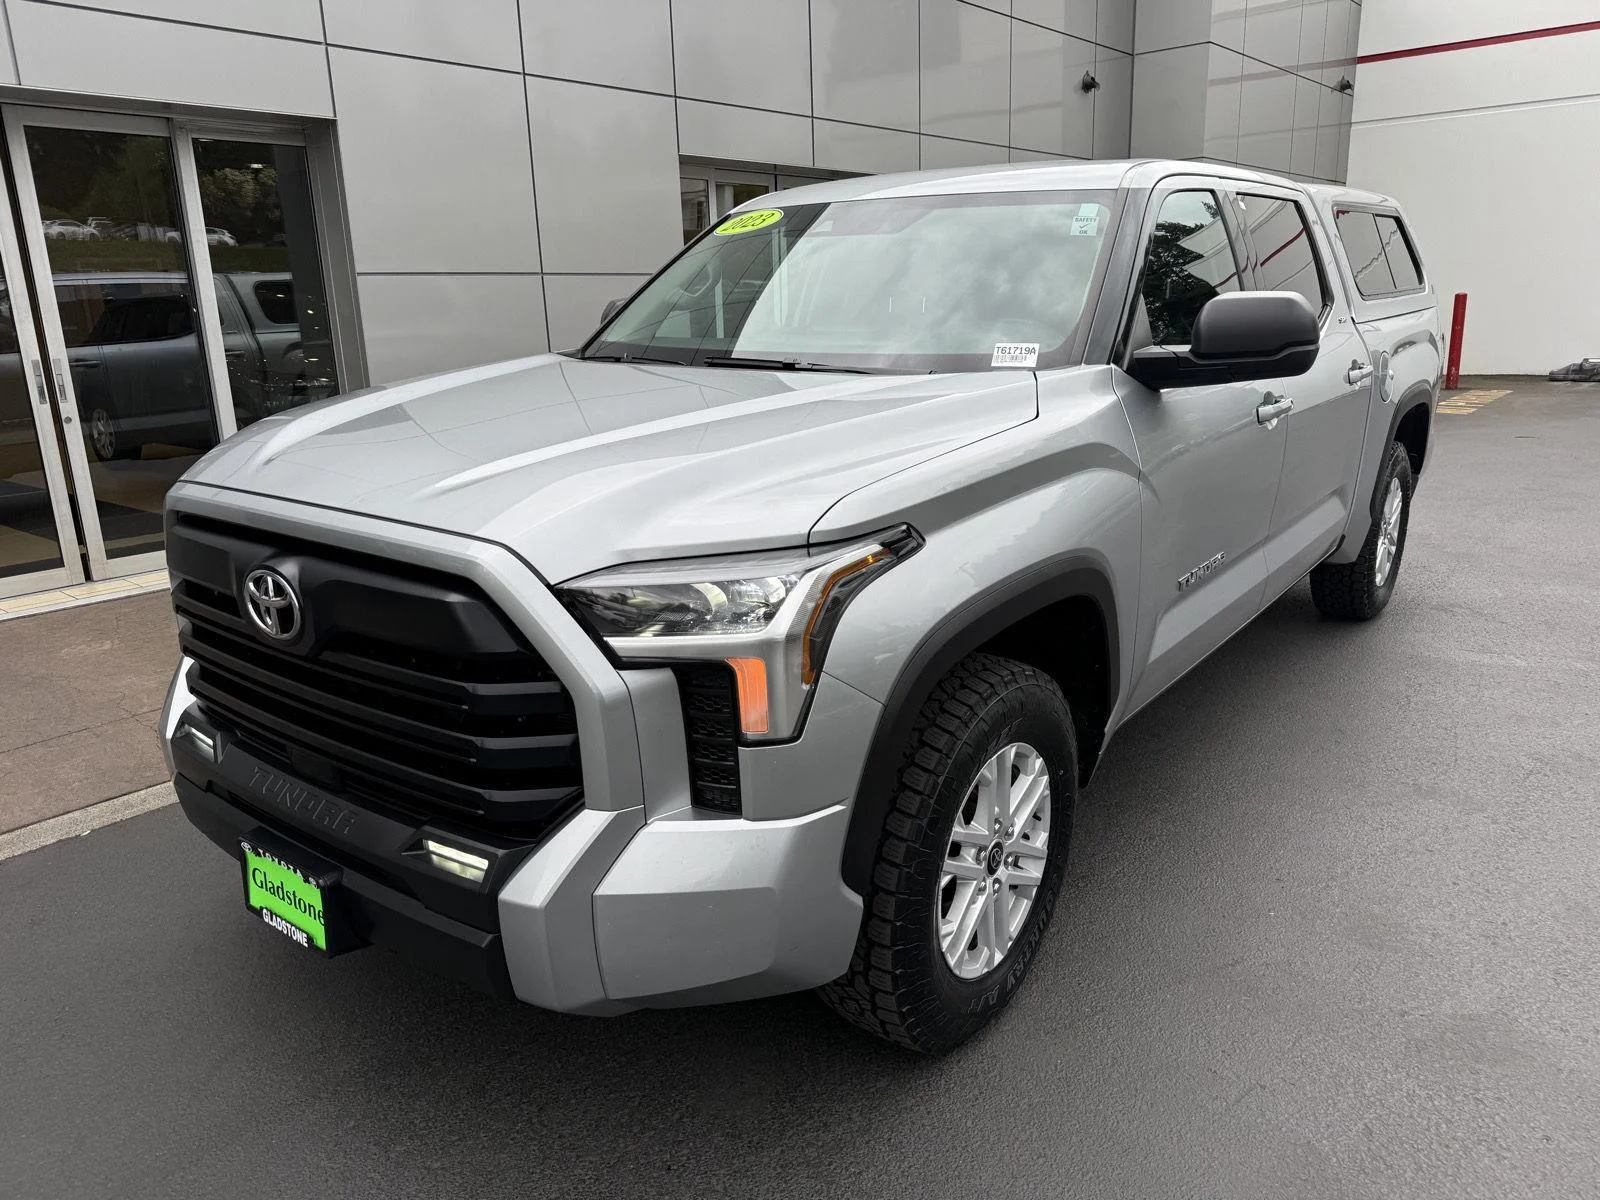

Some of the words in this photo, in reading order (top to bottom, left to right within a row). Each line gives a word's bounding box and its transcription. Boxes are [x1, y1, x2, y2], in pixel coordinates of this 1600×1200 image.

[719, 212, 775, 233] 2023
[995, 346, 1036, 355] T61719A
[248, 765, 357, 834] TUNDRA
[257, 847, 304, 880] TOYOTA
[252, 867, 325, 926] Gladstone
[262, 908, 309, 948] GLADSTONE
